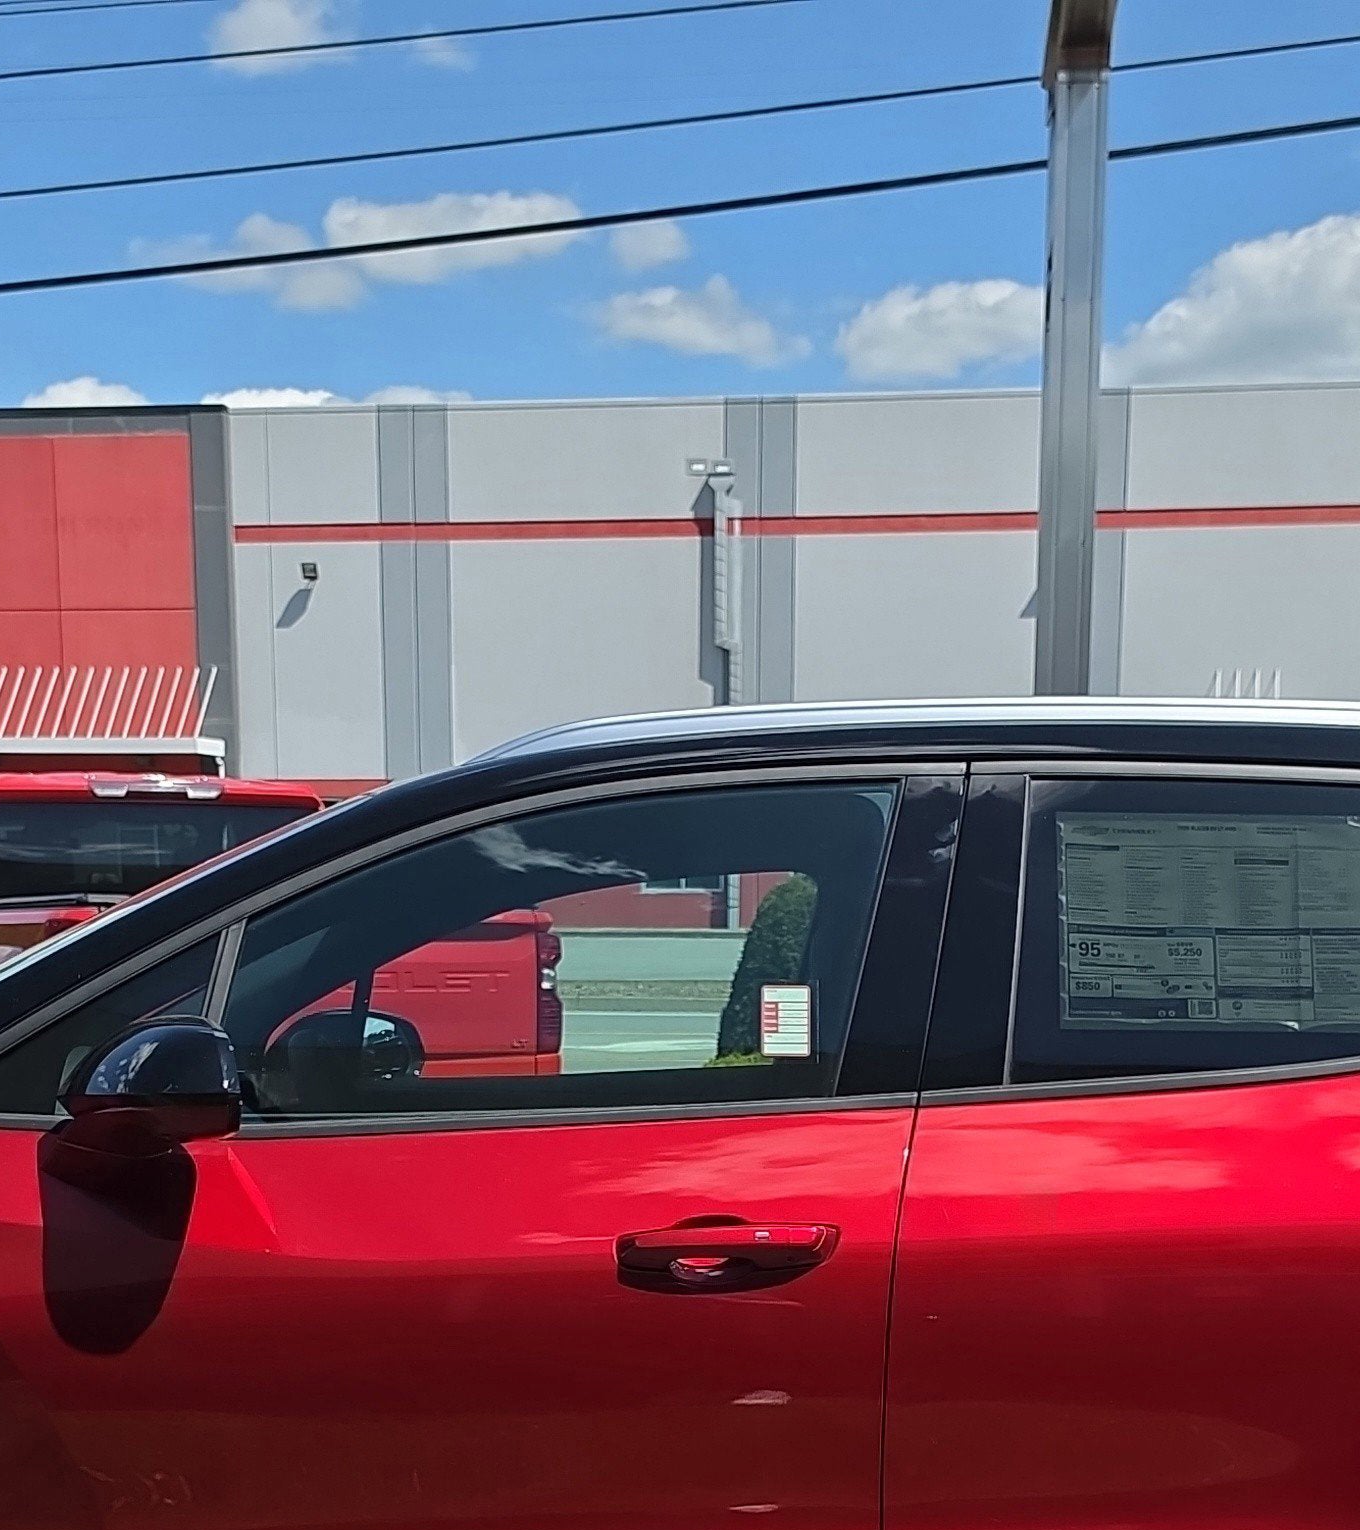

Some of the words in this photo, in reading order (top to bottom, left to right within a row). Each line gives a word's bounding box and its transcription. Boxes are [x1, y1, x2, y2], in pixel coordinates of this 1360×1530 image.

[1078, 941, 1101, 957] 95
[1167, 947, 1203, 957] $5,250
[1075, 981, 1101, 991] $850
